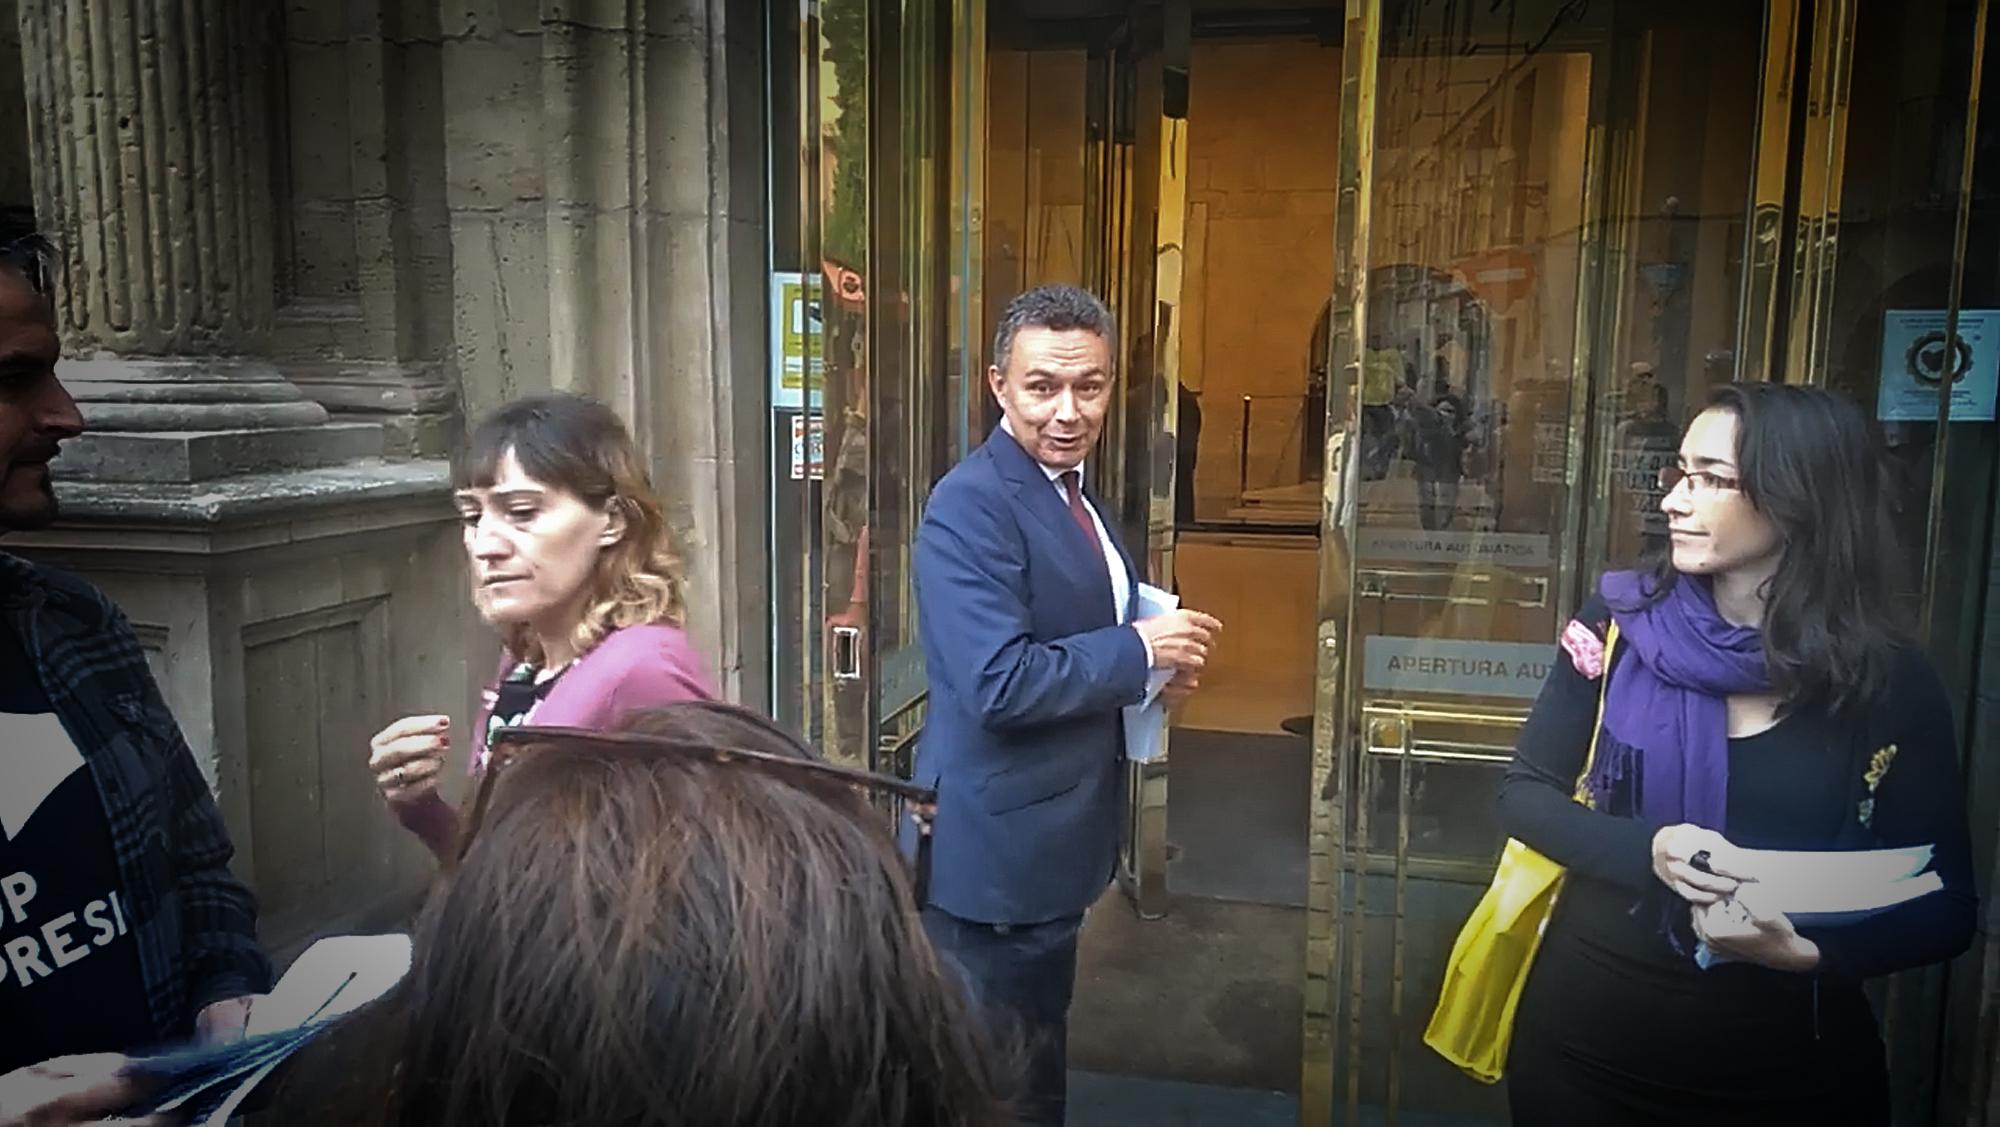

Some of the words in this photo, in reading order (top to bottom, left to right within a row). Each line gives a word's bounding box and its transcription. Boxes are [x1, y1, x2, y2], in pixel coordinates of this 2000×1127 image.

[1446, 542, 1535, 556] AUTMATICA
[1387, 655, 1509, 677] APERTURA
[0, 871, 37, 931] P
